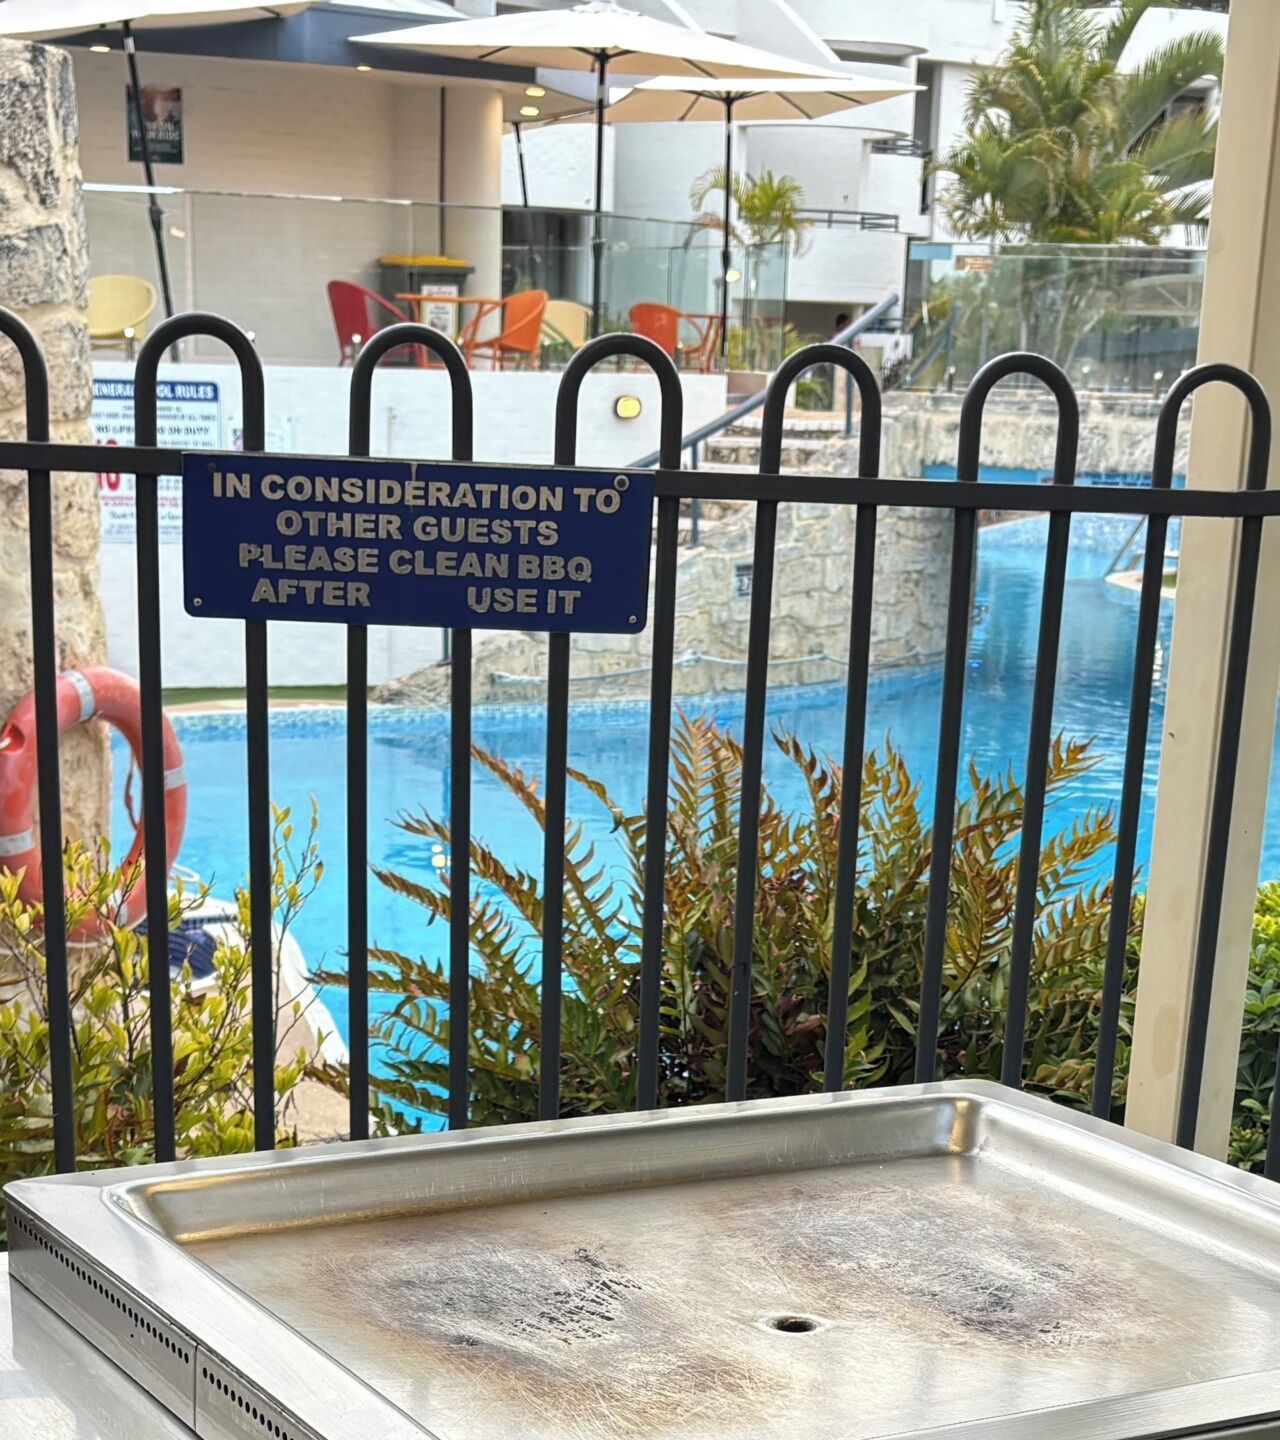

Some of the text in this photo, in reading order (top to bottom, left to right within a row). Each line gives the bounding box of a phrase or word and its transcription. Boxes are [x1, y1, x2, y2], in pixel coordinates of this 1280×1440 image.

[175, 384, 215, 399] RULES
[213, 471, 250, 498] IN
[260, 473, 564, 513] CONSIDERATION
[573, 488, 621, 515] TO
[276, 510, 559, 547] OTHER GUESTS
[239, 543, 593, 584] PLEASE CLEAN BBQ
[251, 578, 581, 616] AFTER USE IT
